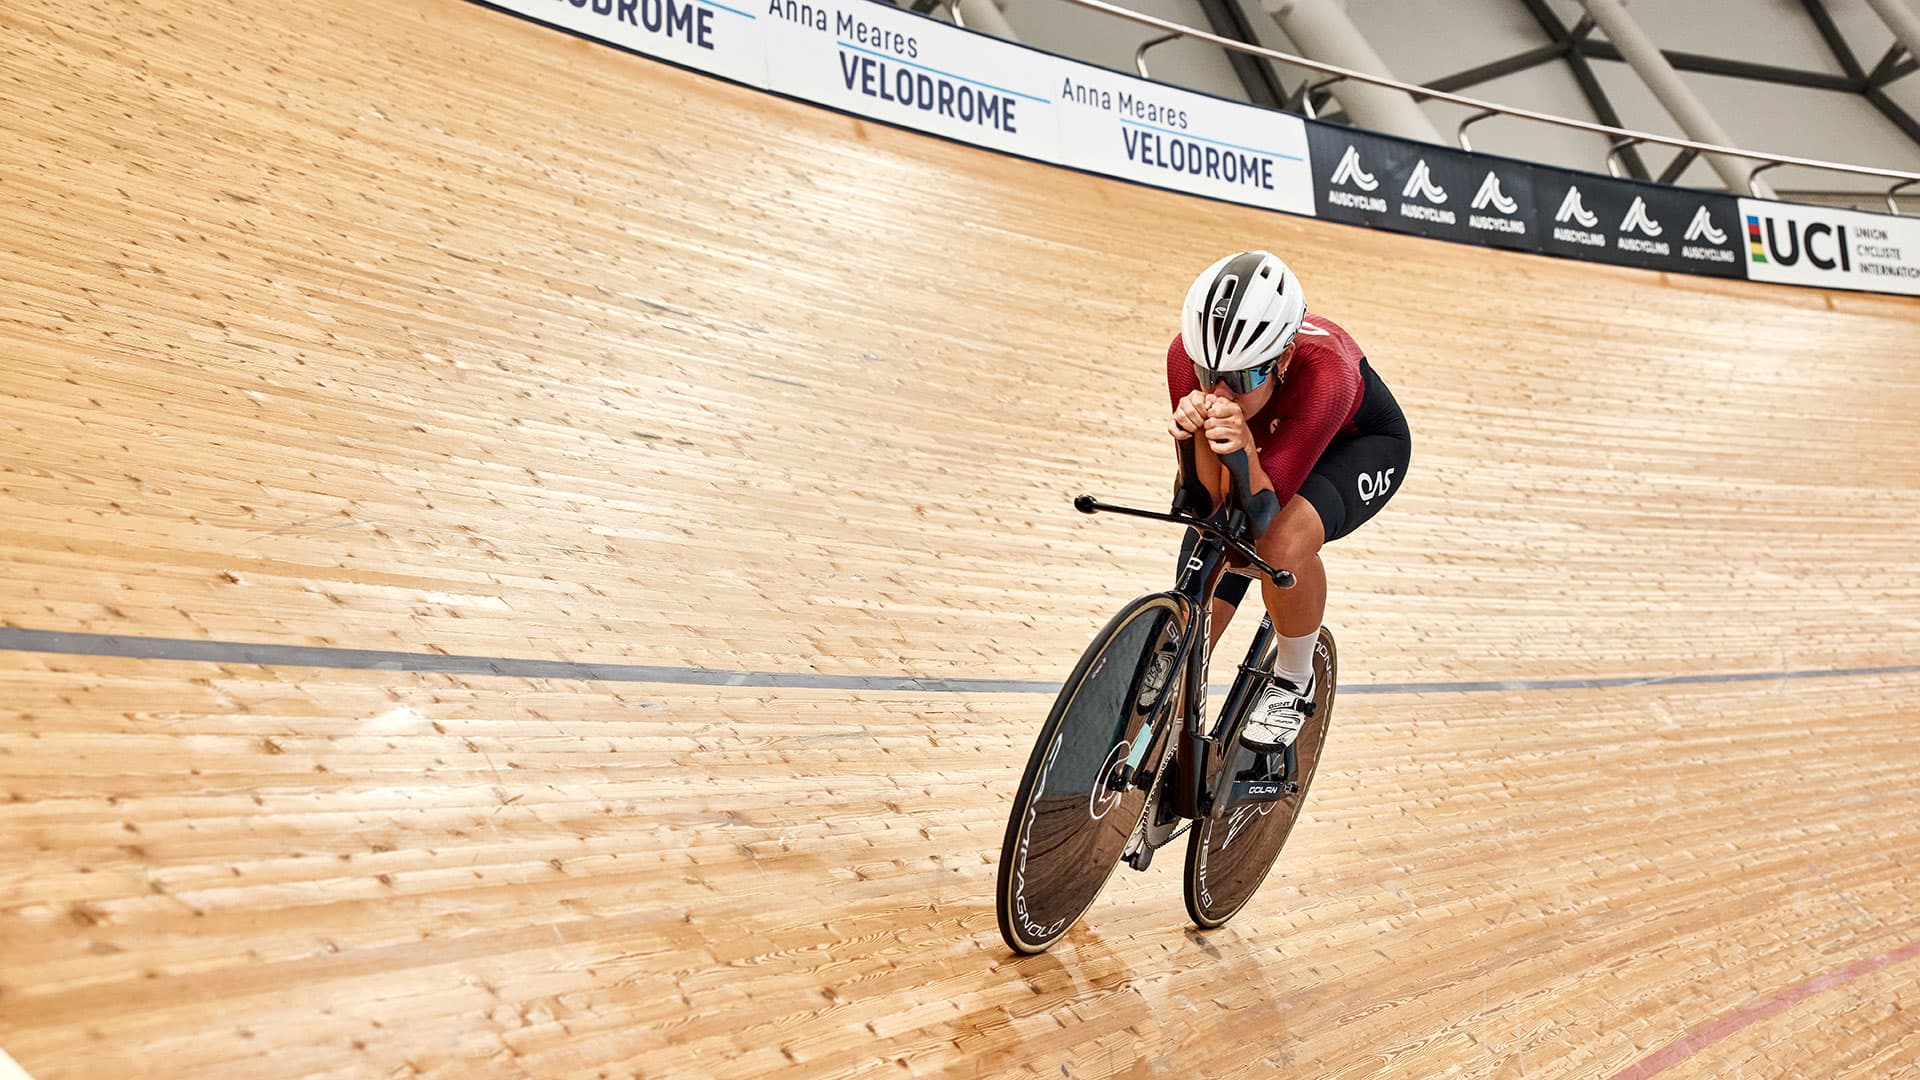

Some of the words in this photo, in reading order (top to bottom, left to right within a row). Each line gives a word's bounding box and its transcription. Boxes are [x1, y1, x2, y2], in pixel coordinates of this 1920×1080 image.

[769, 0, 827, 31] Anna
[836, 10, 918, 59] Meares
[838, 50, 1017, 134] VELODROME
[1062, 77, 1111, 111] Anna
[1118, 91, 1188, 129] Meares
[1122, 127, 1275, 190] VELODROME
[1328, 190, 1388, 213] AUSCYCLING
[1400, 203, 1456, 225] AUSCYCLING
[1468, 215, 1526, 234] AUSCYCLING
[1553, 226, 1606, 247] AUSCYCLING
[1765, 217, 1851, 272] UCI
[1856, 227, 1888, 240] UNION
[1617, 236, 1670, 255] AUSCYCLING
[1682, 246, 1735, 263] AUSCYCLING
[1248, 786, 1278, 795] DOLAN
[1199, 819, 1215, 909] GHIBL
